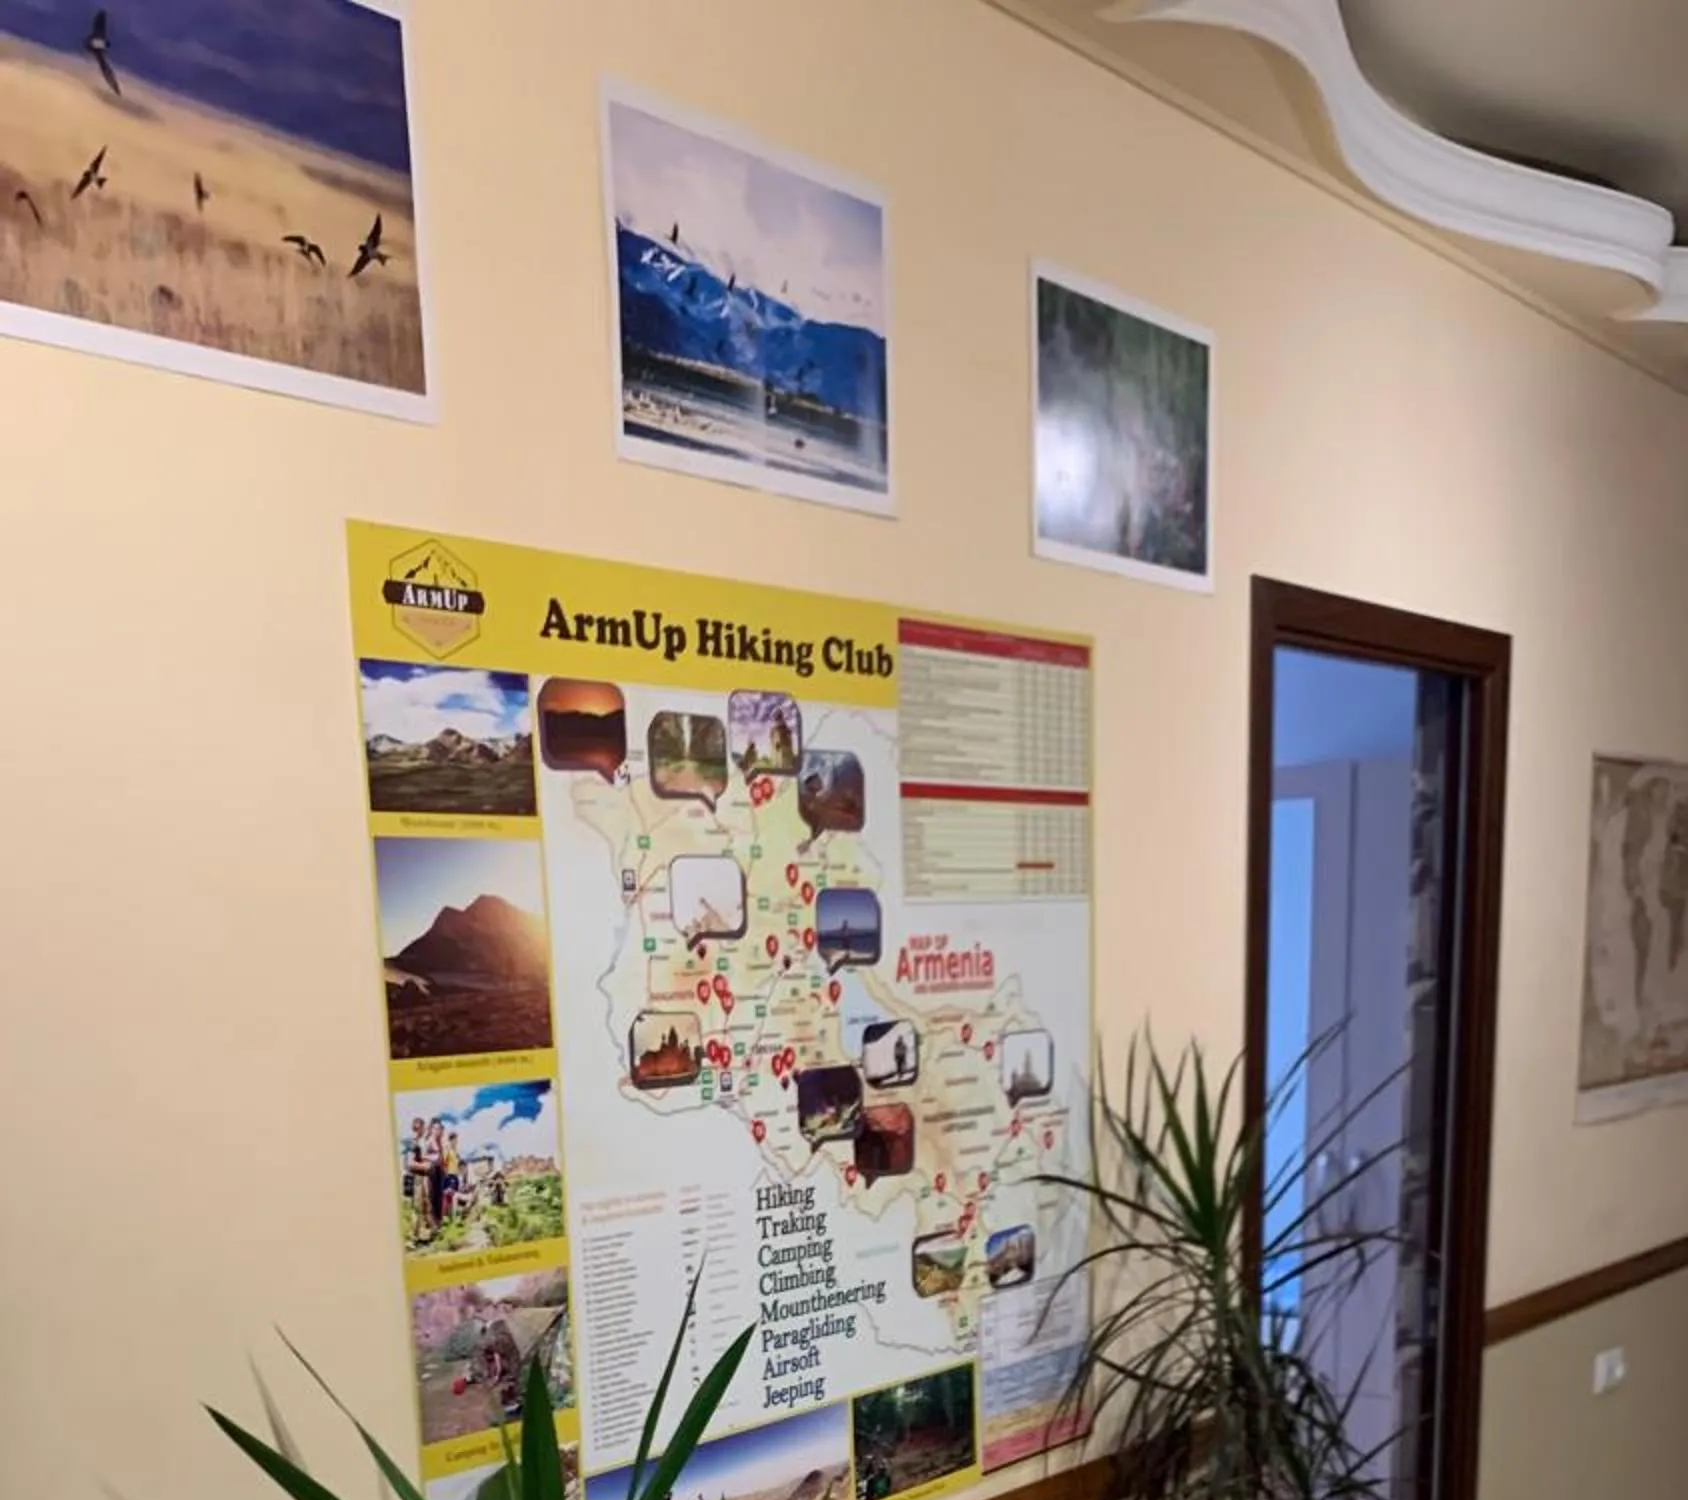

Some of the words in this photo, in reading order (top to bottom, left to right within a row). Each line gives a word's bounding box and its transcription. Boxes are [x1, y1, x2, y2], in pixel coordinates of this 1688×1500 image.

[540, 598, 687, 661] ArmUp
[696, 618, 815, 678] Hiking
[822, 636, 893, 677] Club
[896, 942, 993, 982] Armenia
[756, 1184, 815, 1211] Hiking
[756, 1212, 827, 1239] Traking
[758, 1236, 834, 1268] Camping
[760, 1263, 836, 1296] Climbing
[761, 1280, 886, 1325] Mounthenering
[762, 1315, 856, 1352] Paragliding
[763, 1346, 821, 1380] Airsoft
[764, 1376, 826, 1408] Jeeping
